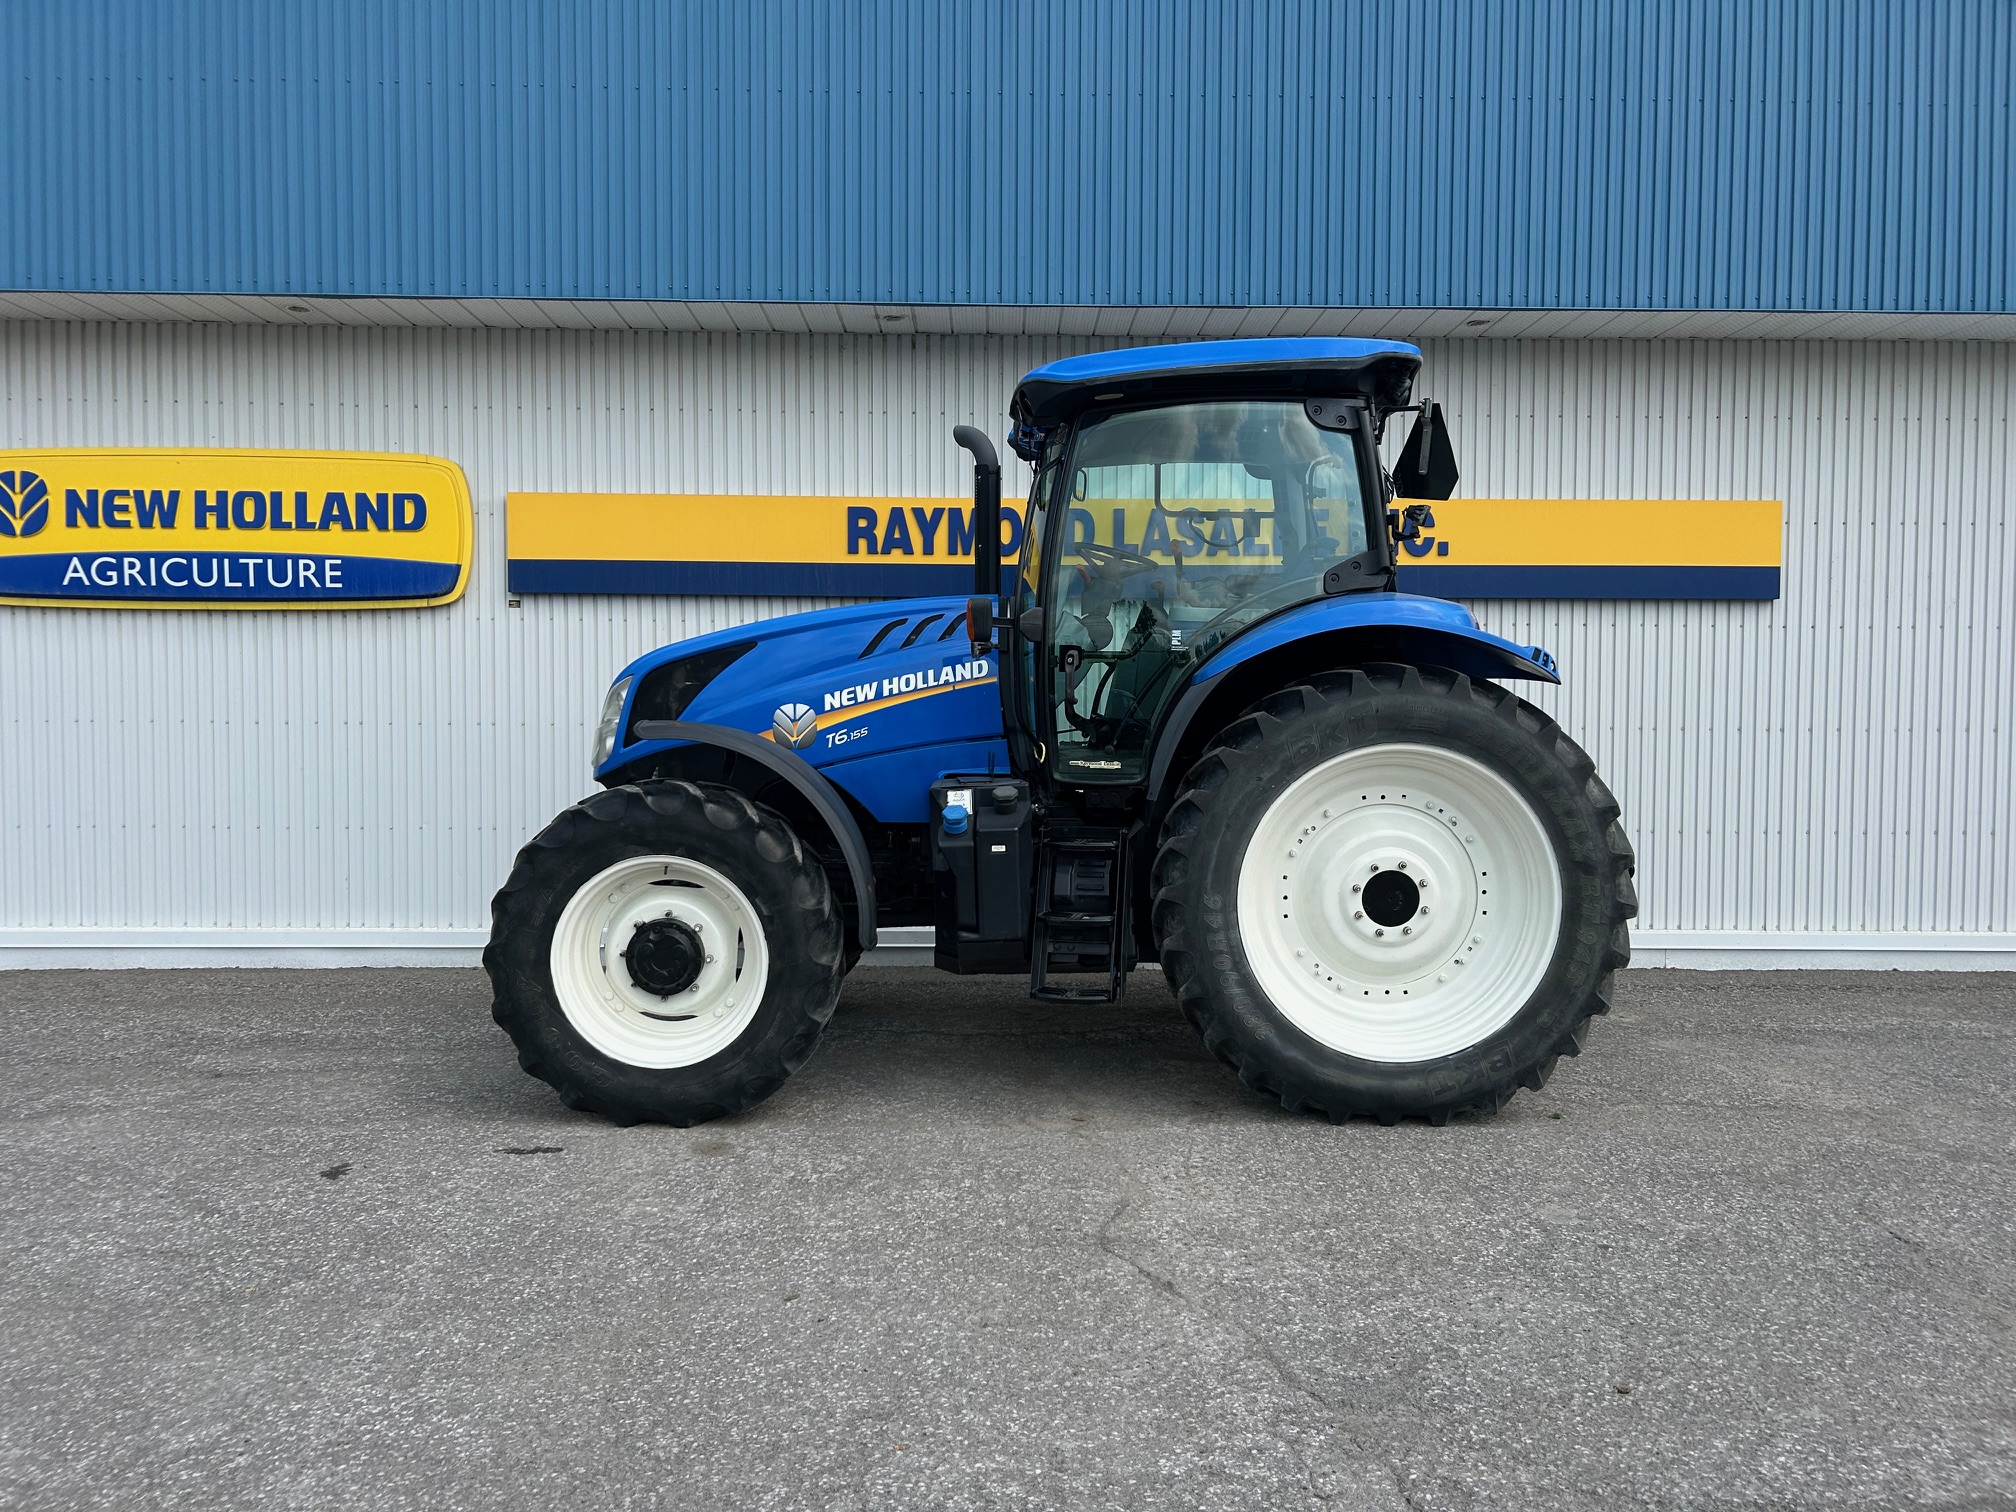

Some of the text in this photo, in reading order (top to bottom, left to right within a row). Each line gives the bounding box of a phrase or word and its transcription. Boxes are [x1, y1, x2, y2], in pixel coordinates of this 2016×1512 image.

[65, 488, 428, 531] NEW HOLLAND
[846, 505, 1096, 557] RAYMOD
[62, 556, 343, 588] AGRICULTURE
[824, 659, 989, 712] NEW HOLLAND
[825, 726, 869, 749] T6.155
